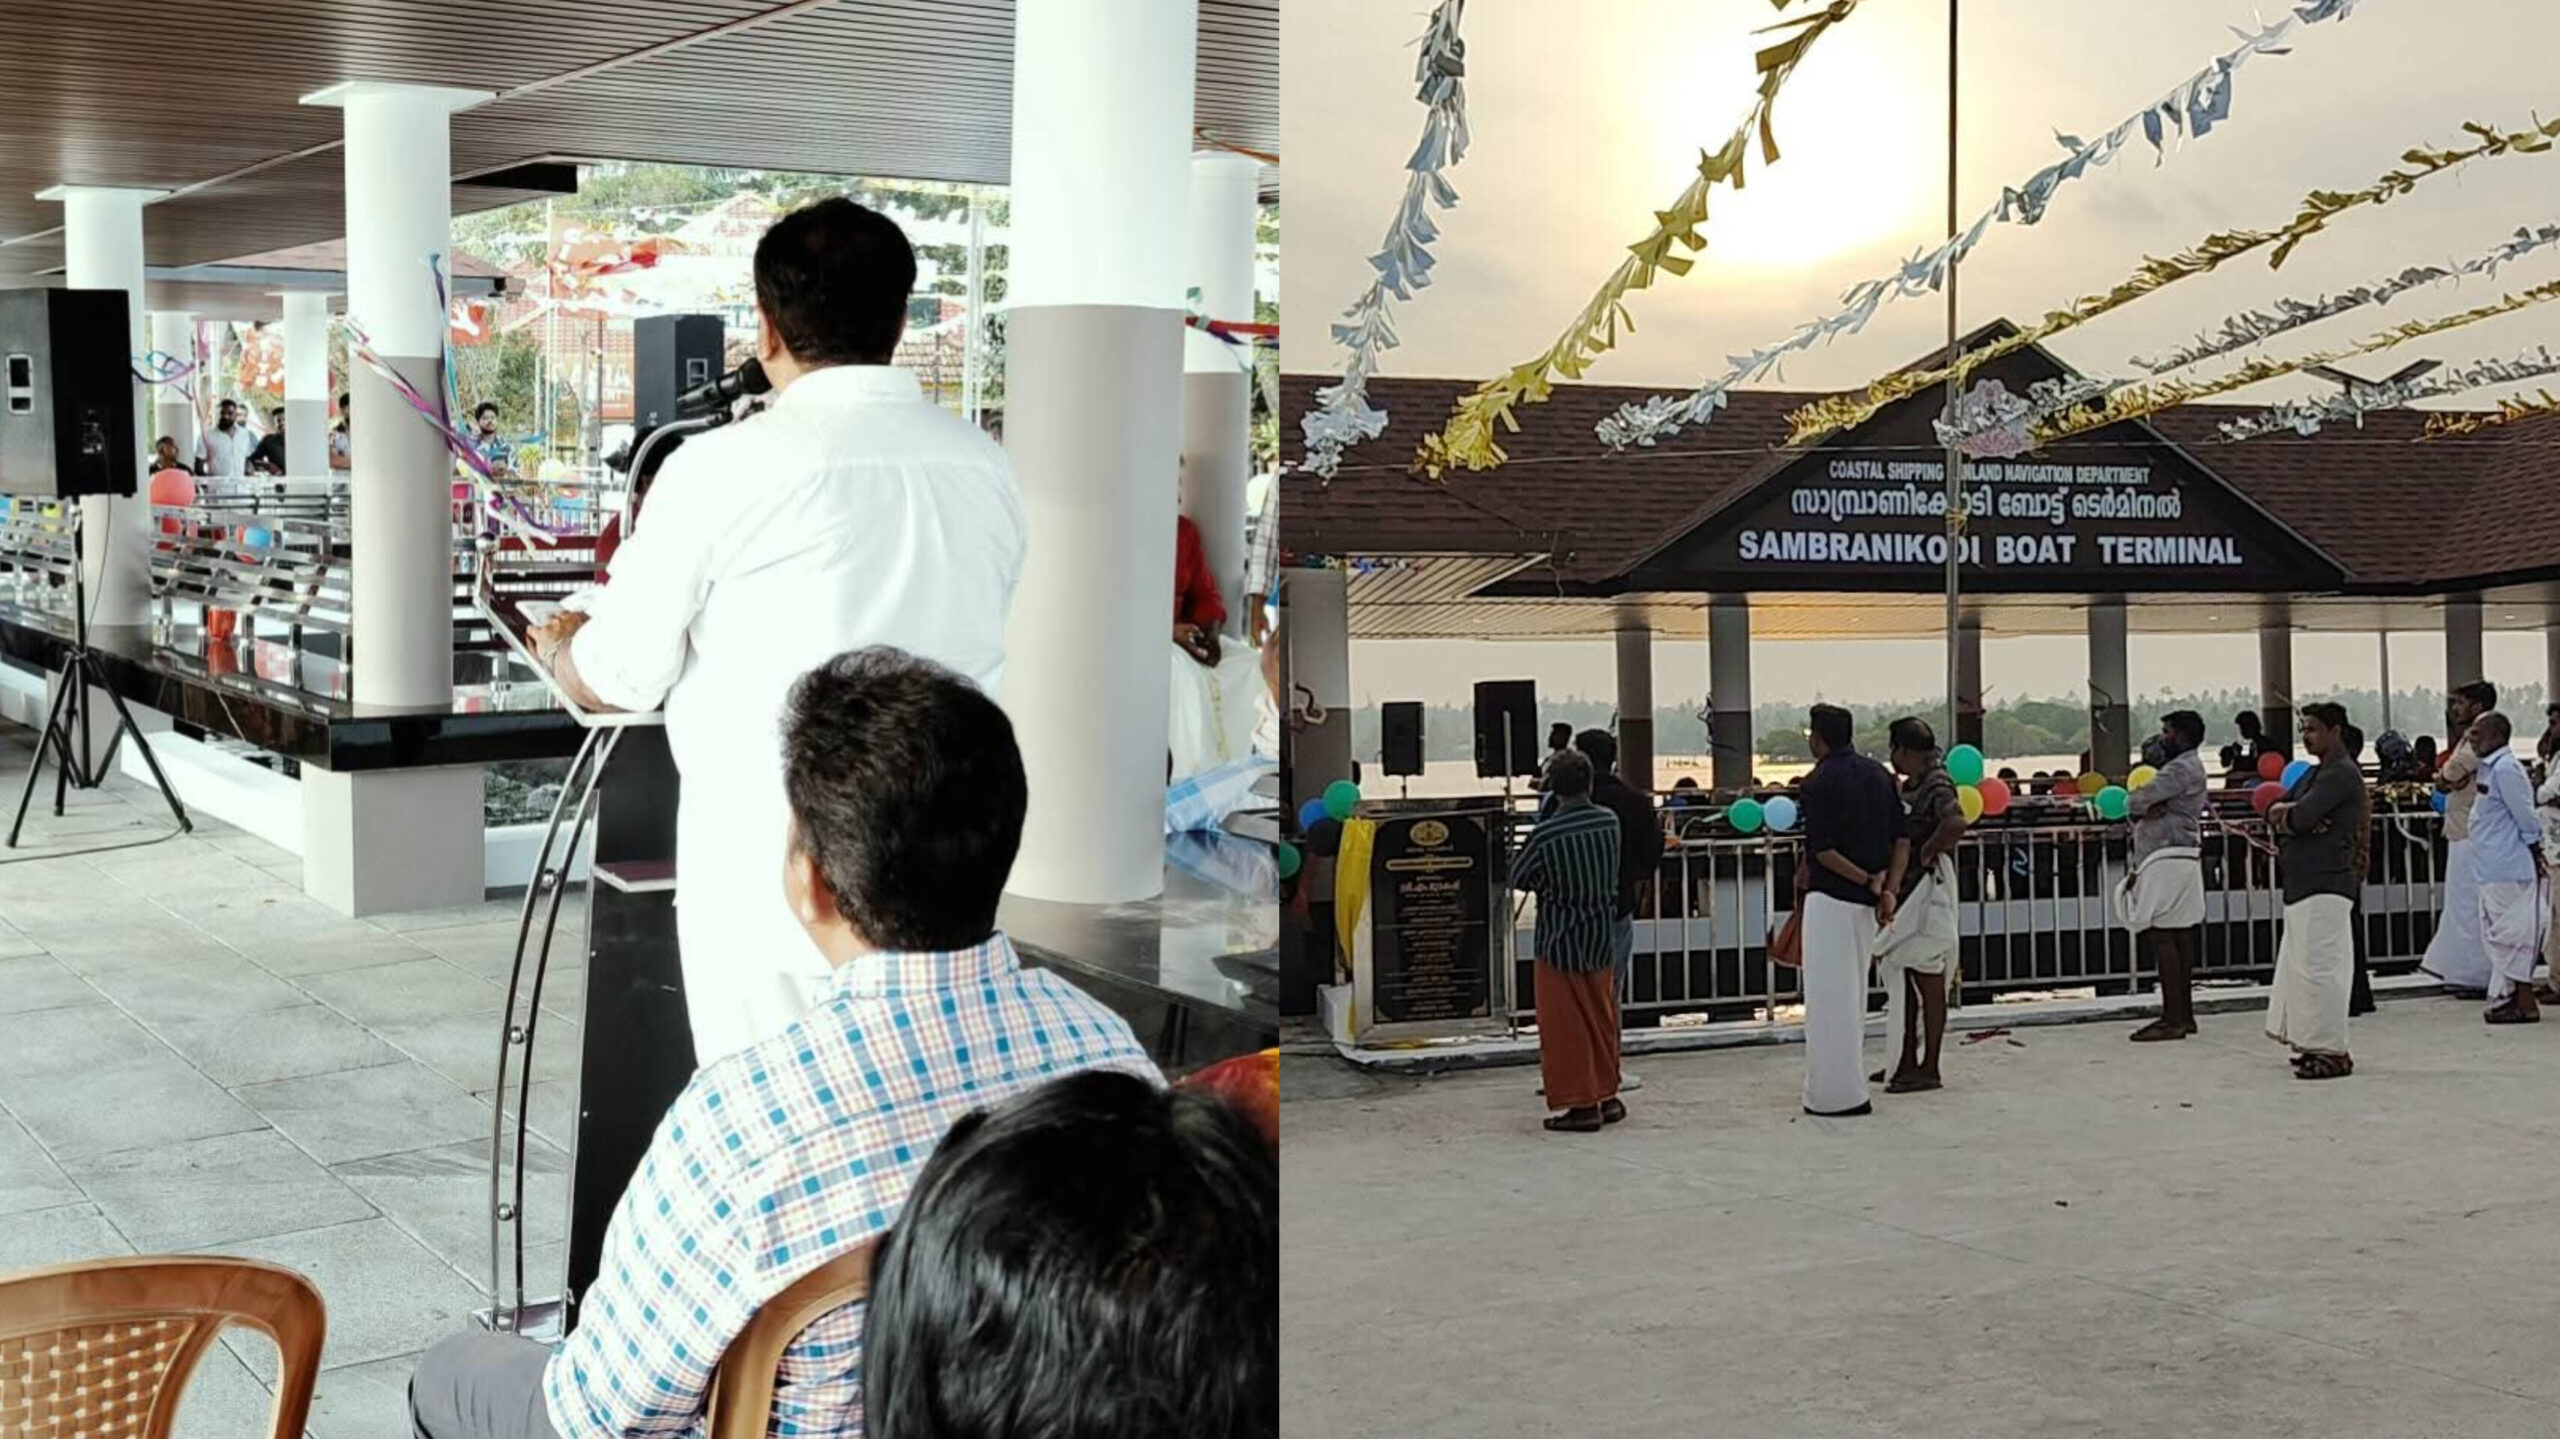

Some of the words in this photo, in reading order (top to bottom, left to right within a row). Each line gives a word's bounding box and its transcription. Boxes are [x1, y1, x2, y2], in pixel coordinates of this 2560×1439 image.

[1829, 460, 1885, 479] COASTAL
[1888, 462, 1944, 481] SHIPPING
[2005, 464, 2073, 482] NAVIGATION
[2076, 466, 2150, 484] DEPARTMENT
[1998, 486, 2069, 525] ബോട്ട്
[2072, 486, 2181, 519] ടെർമിനൽ
[1996, 535, 2076, 564] BOAT
[2097, 536, 2243, 564] TERMINAL
